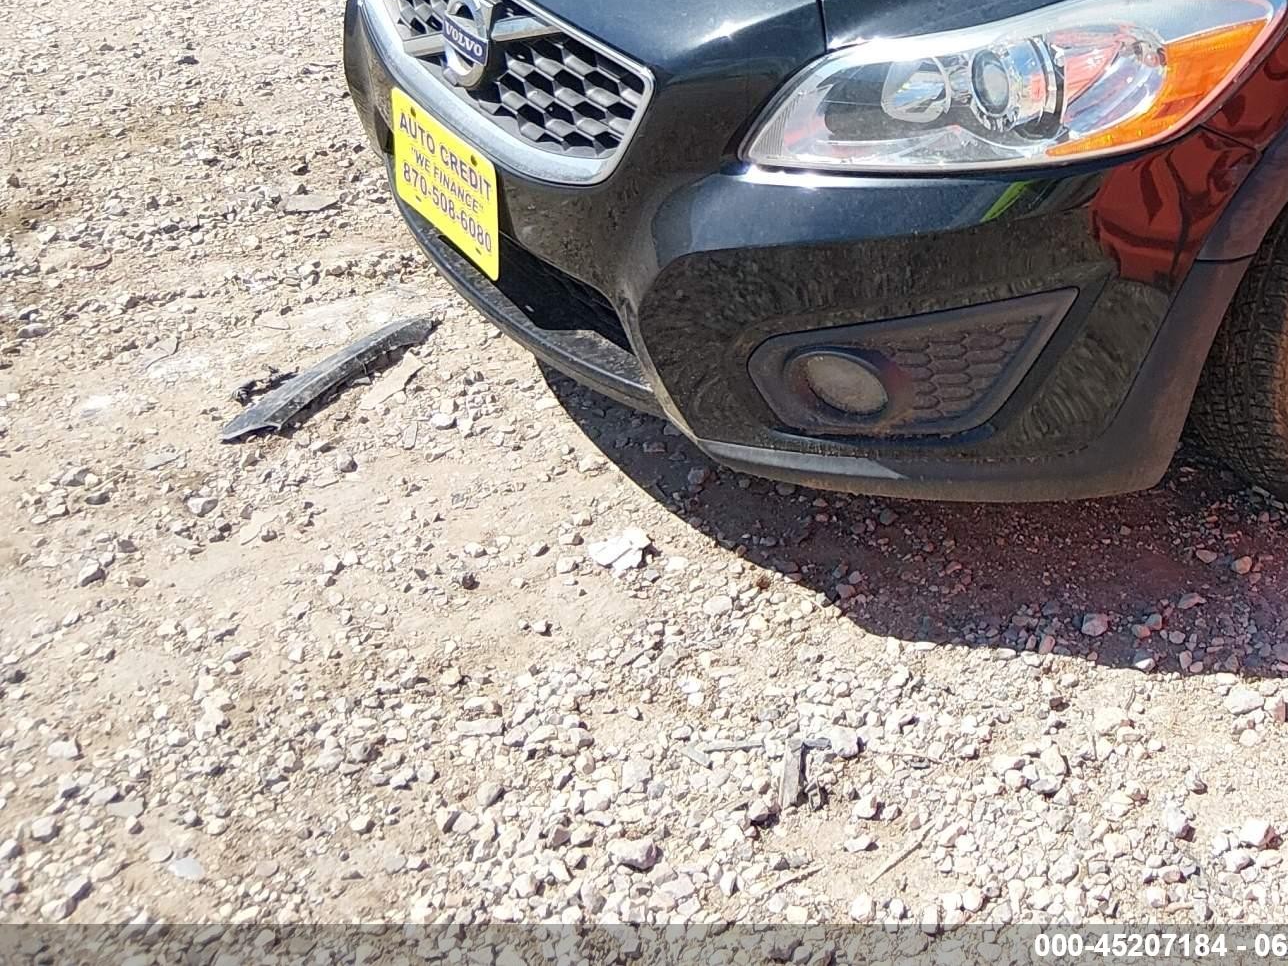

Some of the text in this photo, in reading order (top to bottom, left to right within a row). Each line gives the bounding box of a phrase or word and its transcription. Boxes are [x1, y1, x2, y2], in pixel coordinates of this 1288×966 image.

[445, 20, 483, 56] VOLVO
[400, 112, 492, 202] AUTO CREDIT
[403, 161, 492, 253] 870-508-6080
